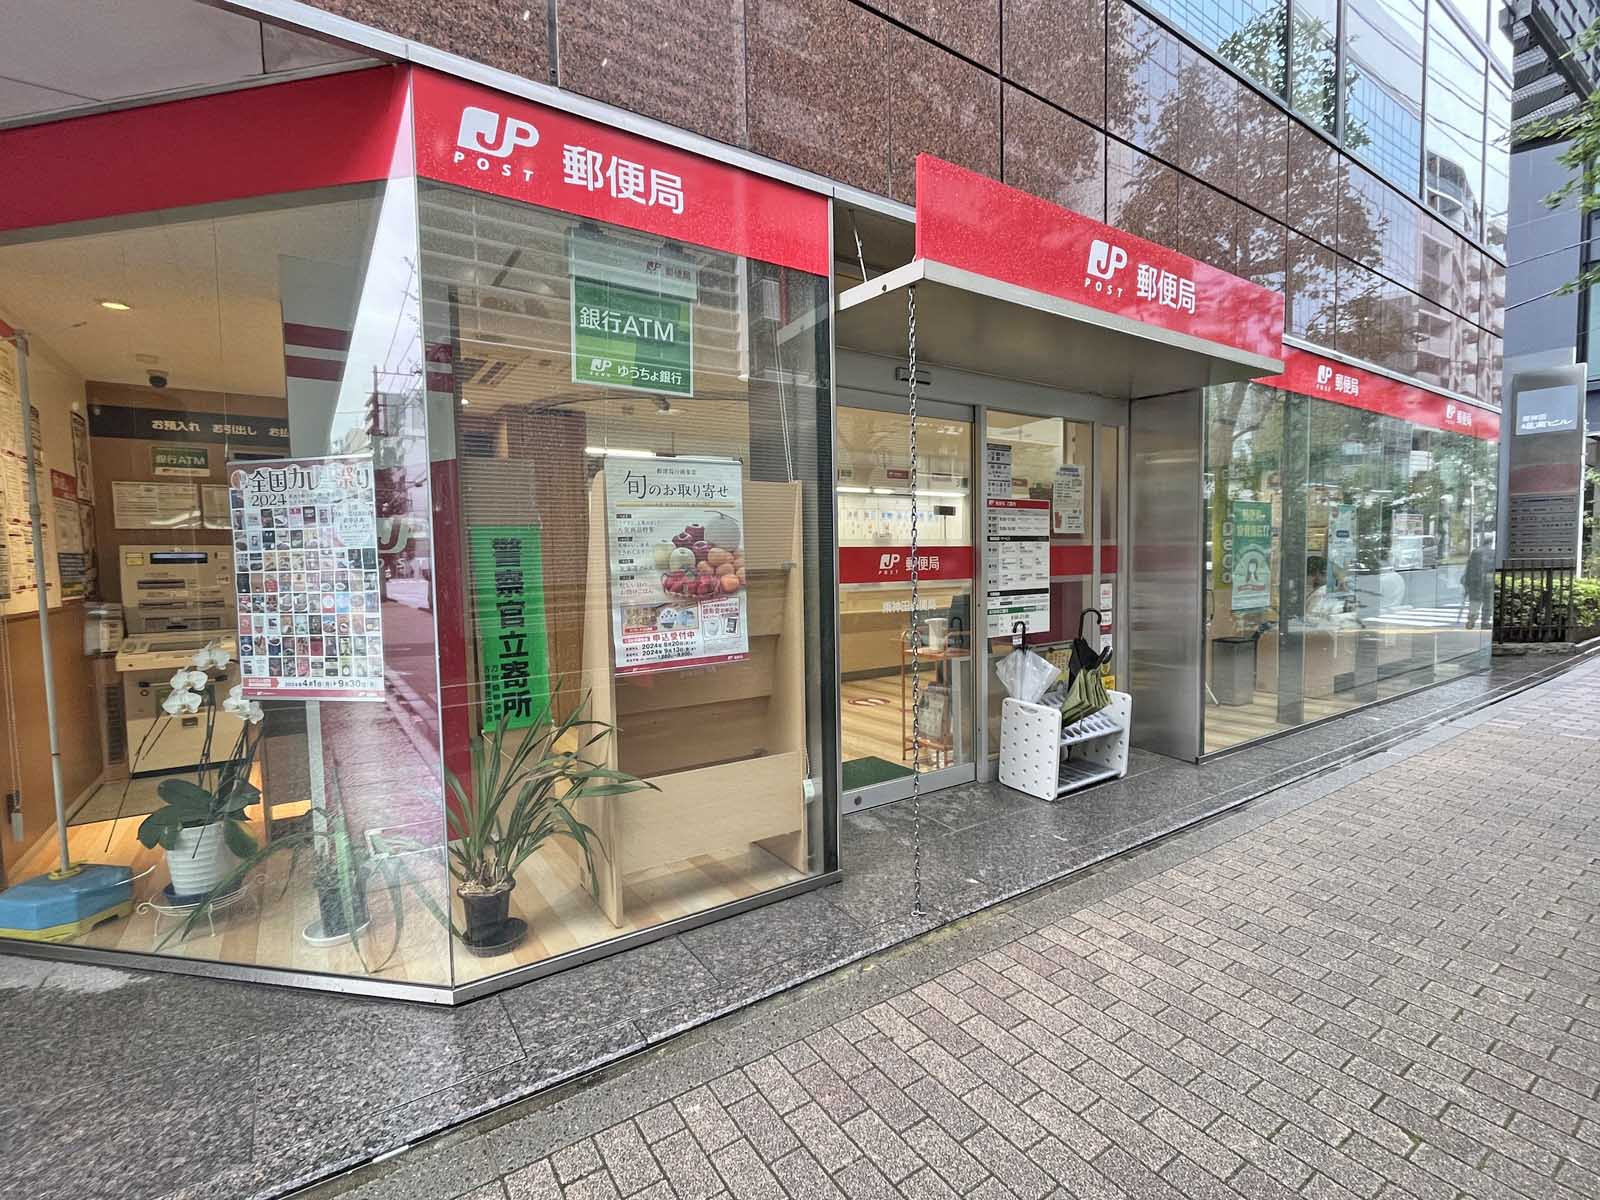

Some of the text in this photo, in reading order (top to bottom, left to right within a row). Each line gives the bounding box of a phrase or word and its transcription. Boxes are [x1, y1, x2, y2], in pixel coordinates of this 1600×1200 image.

[453, 151, 534, 183] POST
[457, 106, 685, 215] JP 郵便局
[1084, 277, 1123, 298] POST
[1087, 239, 1196, 315] JP 郵便局
[579, 306, 675, 342] 銀行ATM
[617, 364, 682, 385] ゆうちょ銀行
[1317, 365, 1360, 397] JP 郵便局
[151, 419, 200, 432] お預入れ
[212, 423, 257, 436] お引出し
[154, 454, 206, 465] 銀行ATM
[249, 464, 369, 493] 全国カレ祭り
[623, 470, 729, 499] 旬のお取り寄せ
[251, 493, 287, 507] 2024
[879, 554, 940, 571] JP 郵便局
[492, 537, 532, 718] 警察官立寄所
[652, 631, 695, 642] 申込受付中
